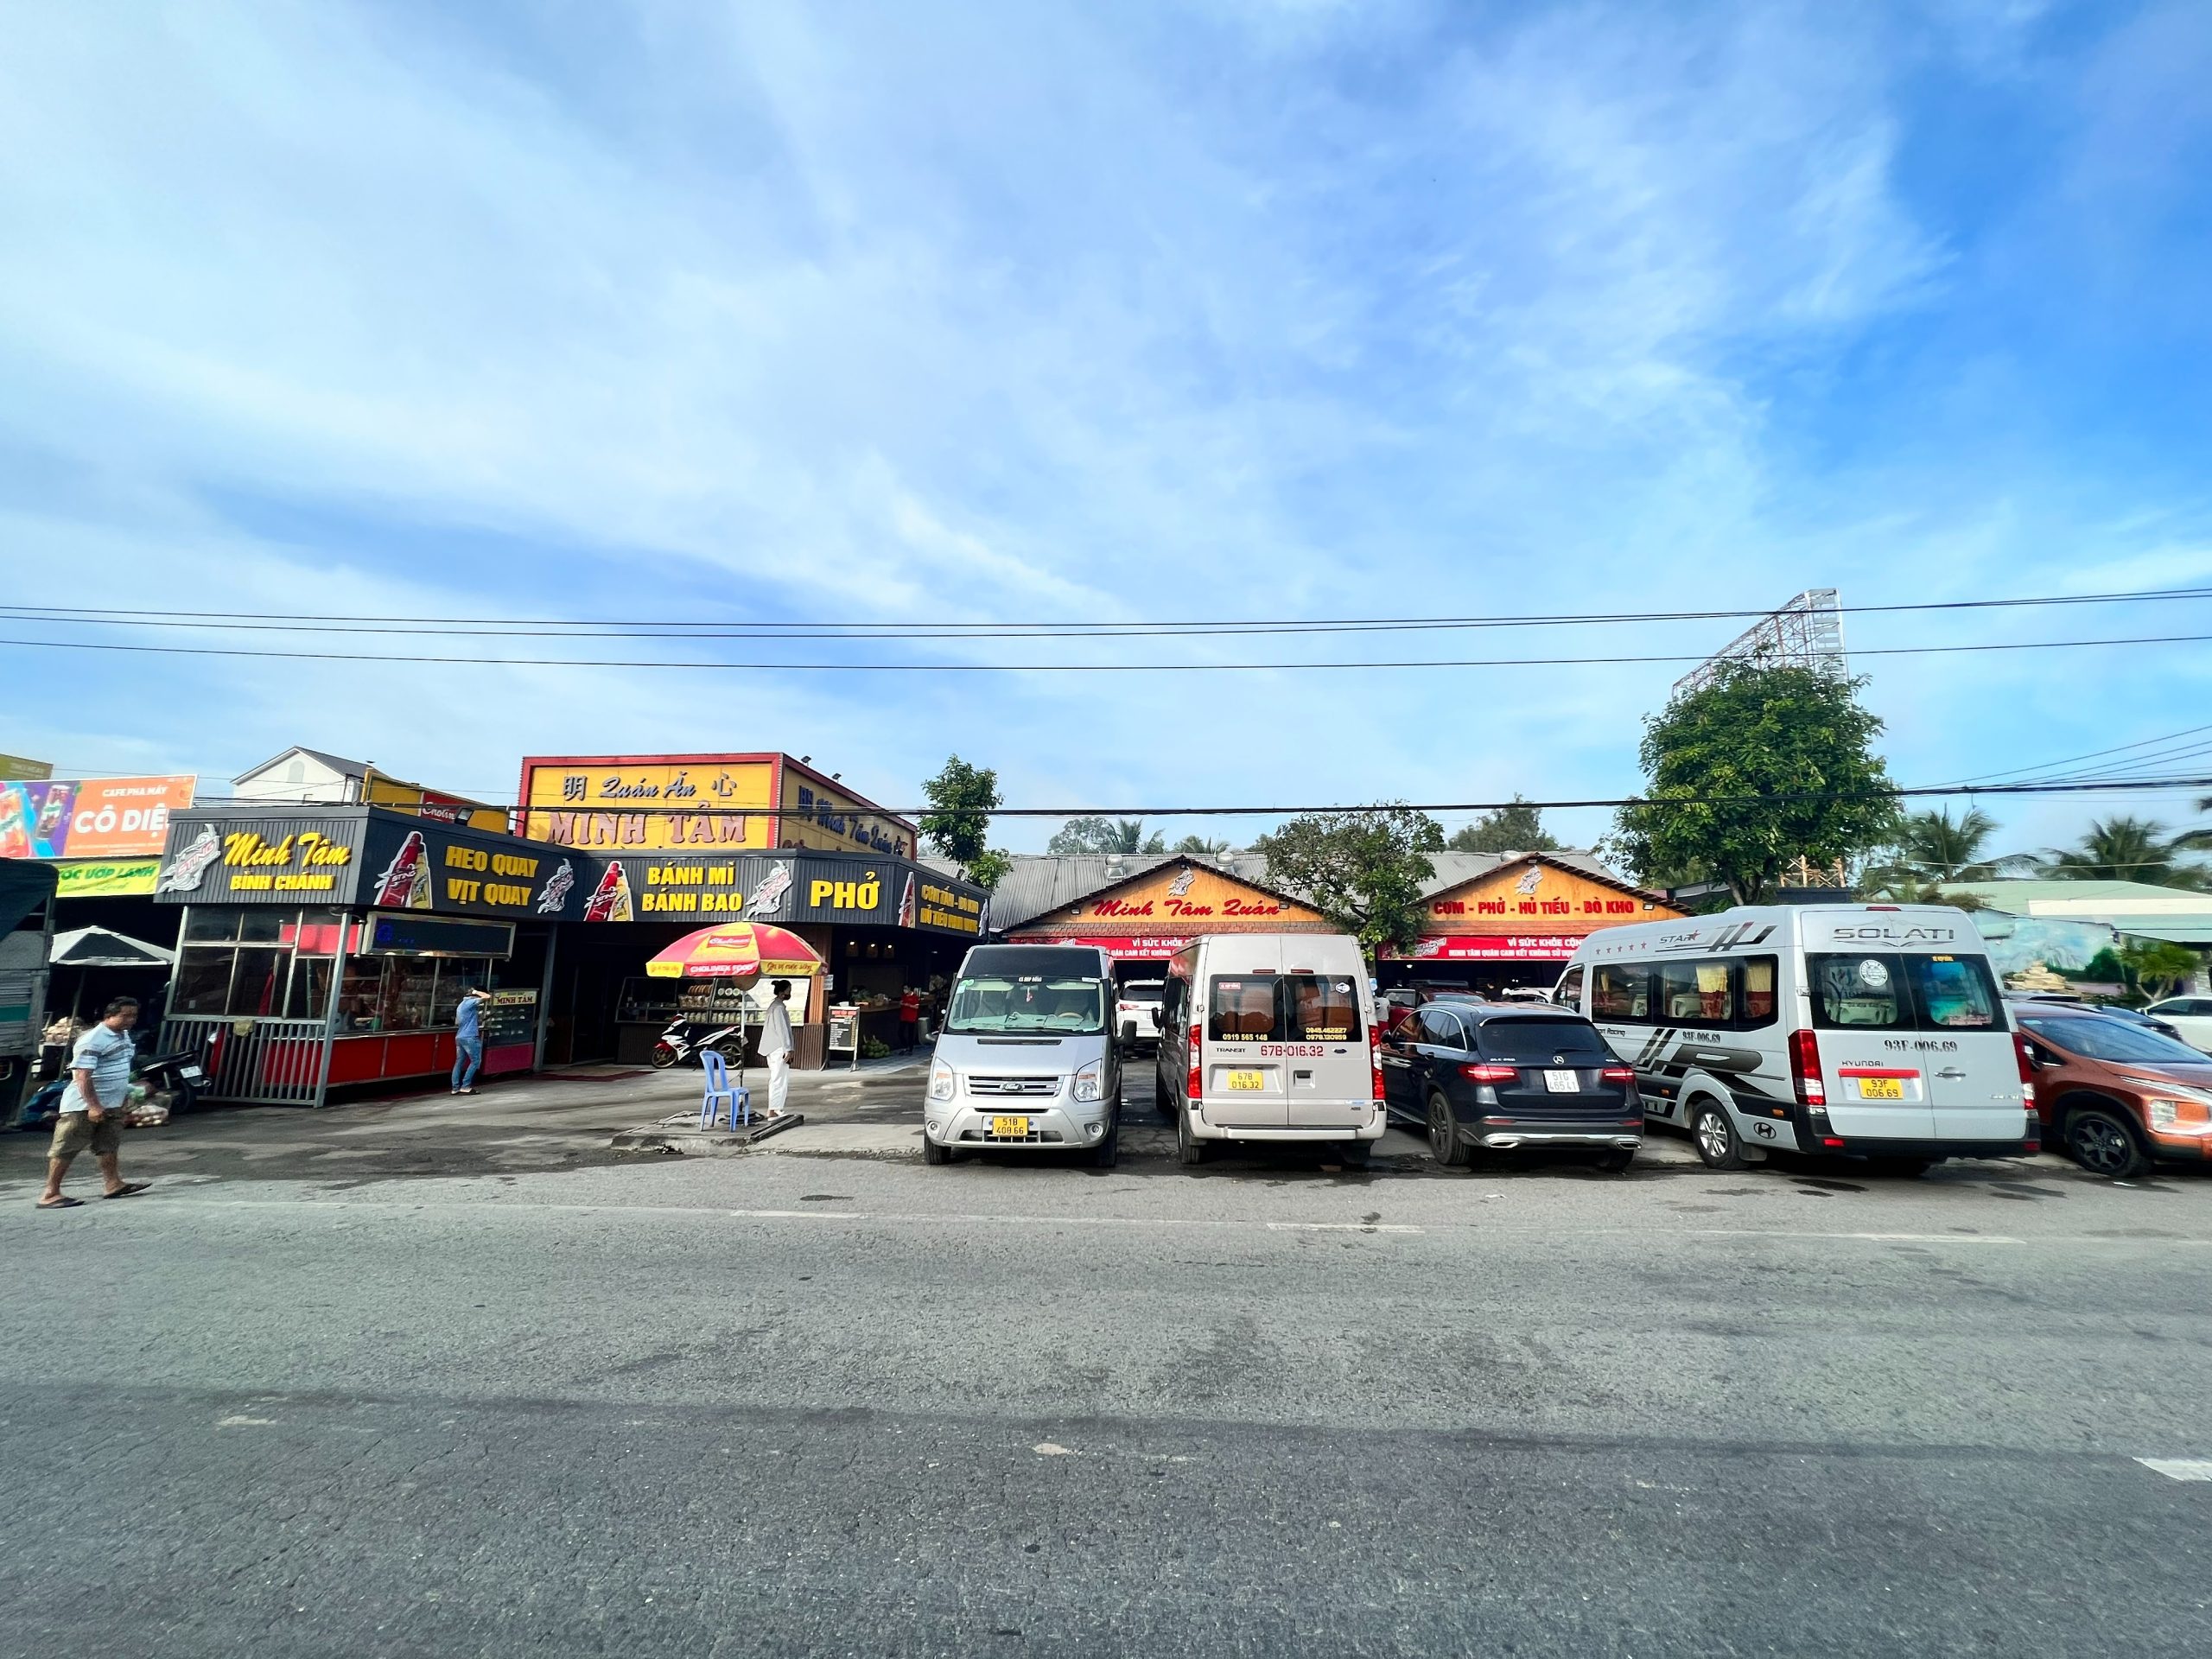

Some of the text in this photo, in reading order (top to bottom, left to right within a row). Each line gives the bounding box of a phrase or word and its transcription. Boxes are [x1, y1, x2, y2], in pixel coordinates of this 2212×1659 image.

[102, 785, 168, 797] CAFE PHA MÁY
[563, 776, 587, 800] 明
[600, 771, 696, 798] Quán Ăn
[711, 772, 737, 797] 心
[74, 803, 170, 837] CÔ DIỆ
[548, 801, 747, 844] MINH TÂM
[224, 832, 352, 868] Minh Tâm
[445, 845, 539, 878] HEO QUAY
[230, 871, 335, 890] BÌNH CHÁNH
[647, 861, 734, 885] BÁNH MÌ
[448, 878, 480, 905] VỊT
[484, 883, 532, 906] QUAY
[641, 888, 696, 912] BÁNH
[701, 893, 743, 912] BAO
[810, 871, 880, 910] PHỞ
[1090, 898, 1280, 917] Minh Tâm Quán
[1433, 900, 1465, 914] CƠM
[1478, 897, 1505, 914] PHỞ
[1519, 897, 1537, 914] HỦ
[1540, 896, 1569, 914] TIẾU
[1584, 896, 1602, 913] BÒ
[1605, 900, 1634, 913] KHO
[1132, 938, 1141, 947] VÌ
[1142, 938, 1159, 947] SỨC
[1161, 937, 1183, 947] KHỎE
[1507, 937, 1583, 948] VÌ SỨC KHỎE CỘN
[1832, 928, 1955, 940] SOLATI
[690, 964, 730, 973] CHOLIMEX
[1871, 1079, 1887, 1088] 93F
[1002, 1117, 1018, 1126] 51B
